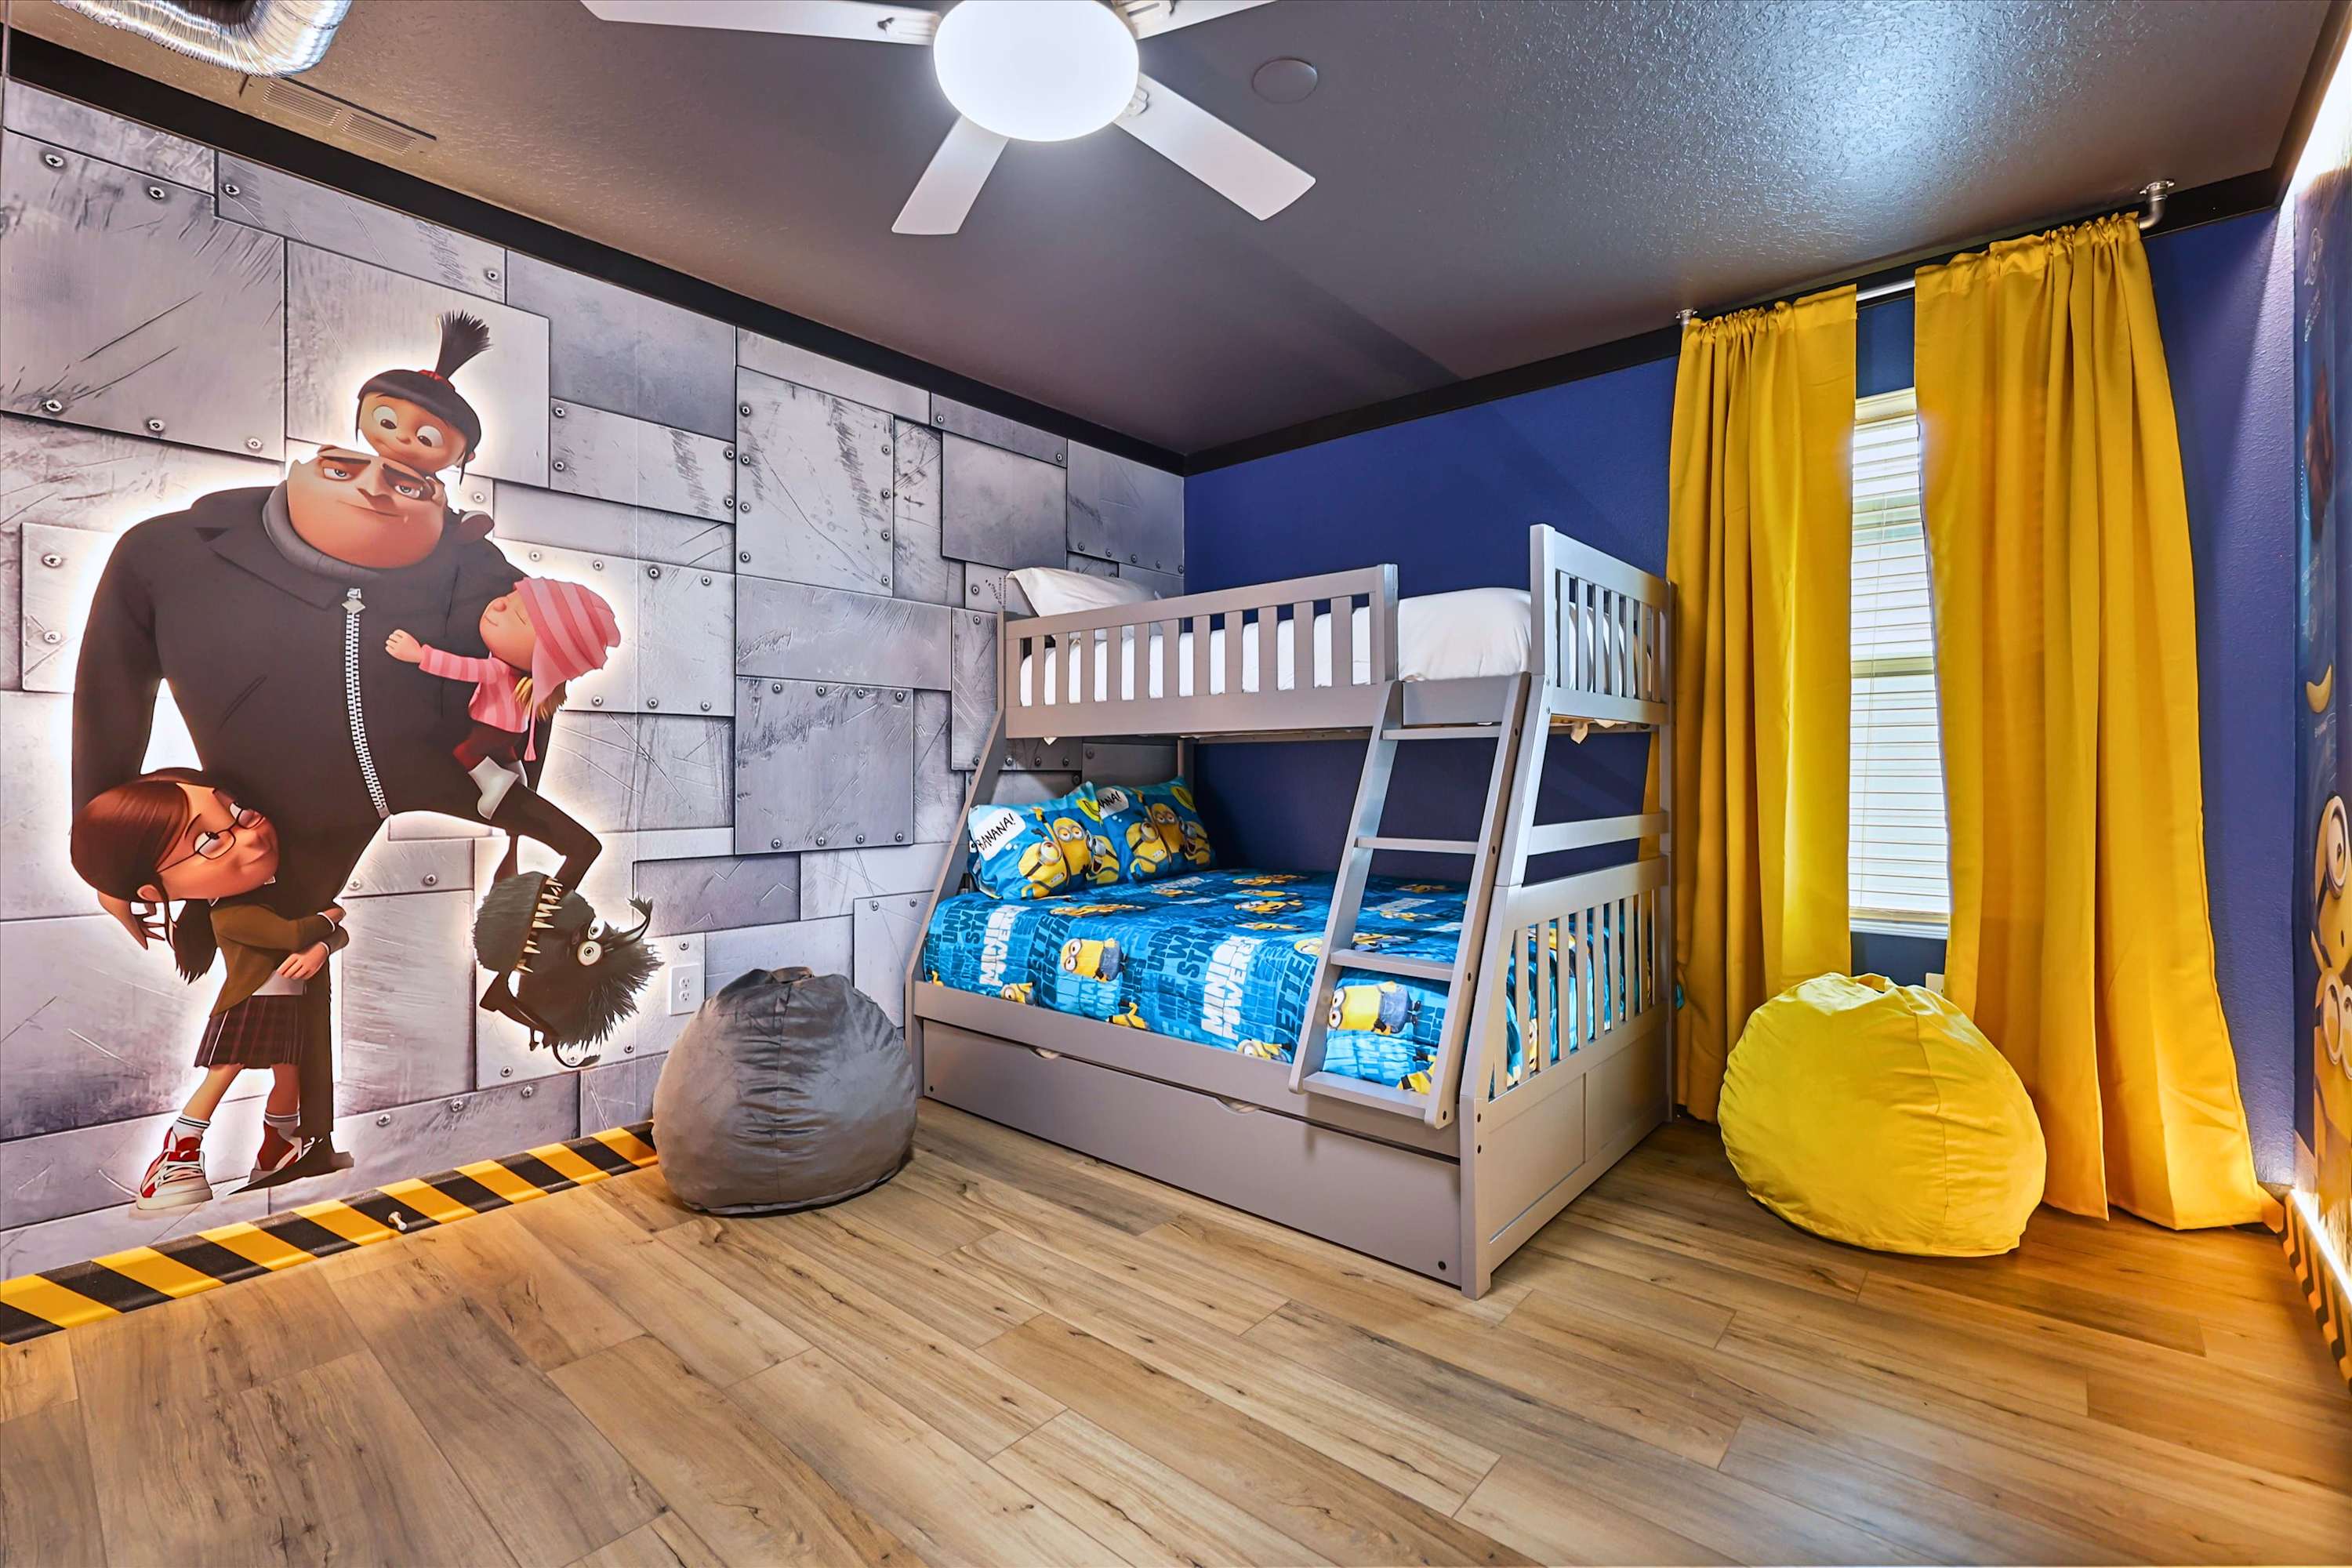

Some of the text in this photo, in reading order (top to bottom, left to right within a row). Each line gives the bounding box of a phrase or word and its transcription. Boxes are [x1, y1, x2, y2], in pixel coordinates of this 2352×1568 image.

[1097, 790, 1122, 809] NANA!
[976, 813, 1016, 851] BANANA!
[1201, 936, 1240, 1037] MINION
